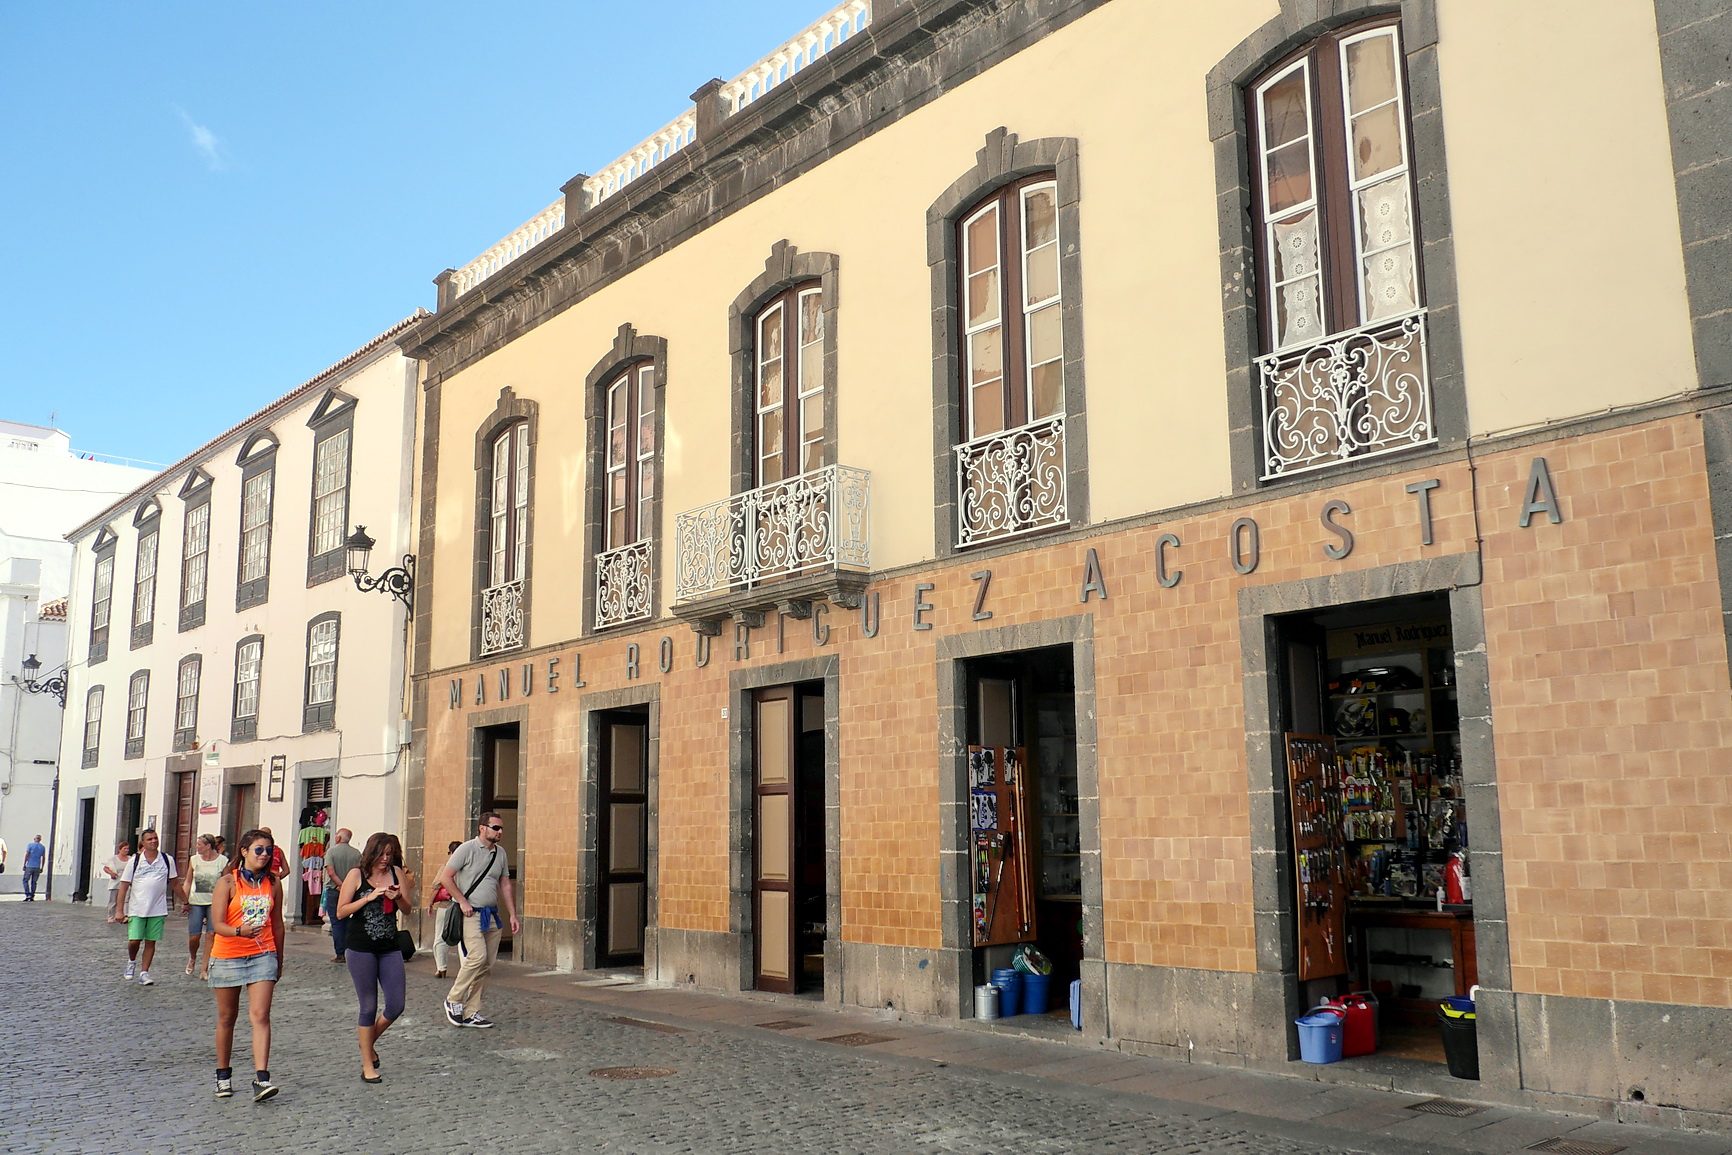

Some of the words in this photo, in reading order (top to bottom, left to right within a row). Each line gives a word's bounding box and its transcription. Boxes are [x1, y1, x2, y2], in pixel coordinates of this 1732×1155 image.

[449, 653, 586, 710] MANUEL
[626, 569, 993, 679] RODRIGUEZ
[1079, 457, 1562, 604] ACOSTA
[1354, 630, 1392, 648] Manuel
[1397, 625, 1449, 642] Rodriguez
